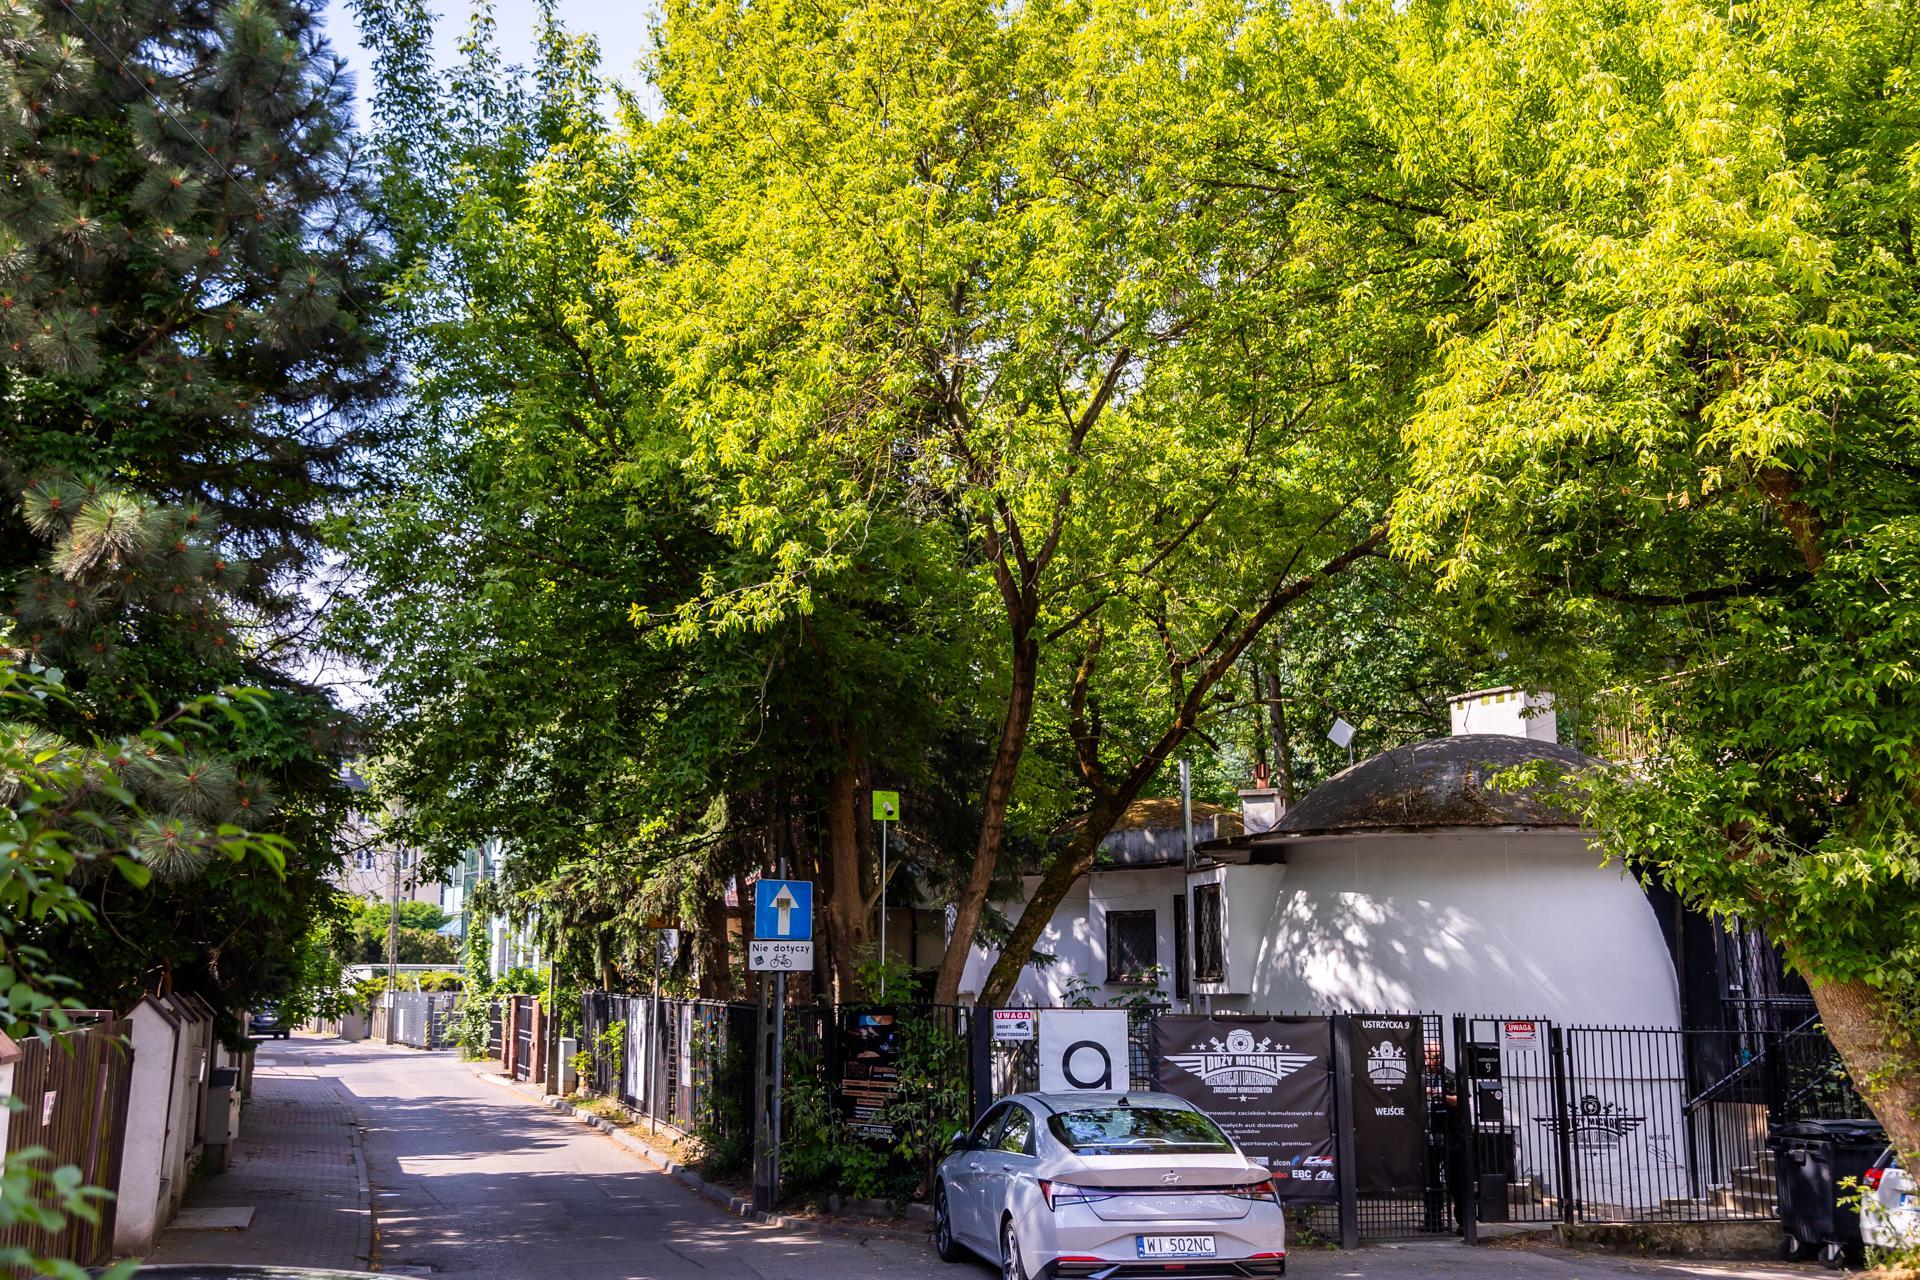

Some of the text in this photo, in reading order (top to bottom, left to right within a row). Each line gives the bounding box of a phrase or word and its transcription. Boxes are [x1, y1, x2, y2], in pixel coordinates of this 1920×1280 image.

[752, 944, 810, 955] Nie dotyczy
[1362, 1020, 1410, 1029] USTRZYCKA 9
[1206, 1054, 1277, 1072] DUŻY MICHAŁ
[1485, 1062, 1492, 1073] 9
[1375, 1106, 1405, 1115] WEJŚCIE
[1291, 1169, 1312, 1178] EBC
[1147, 1238, 1212, 1252] WI 502NC
